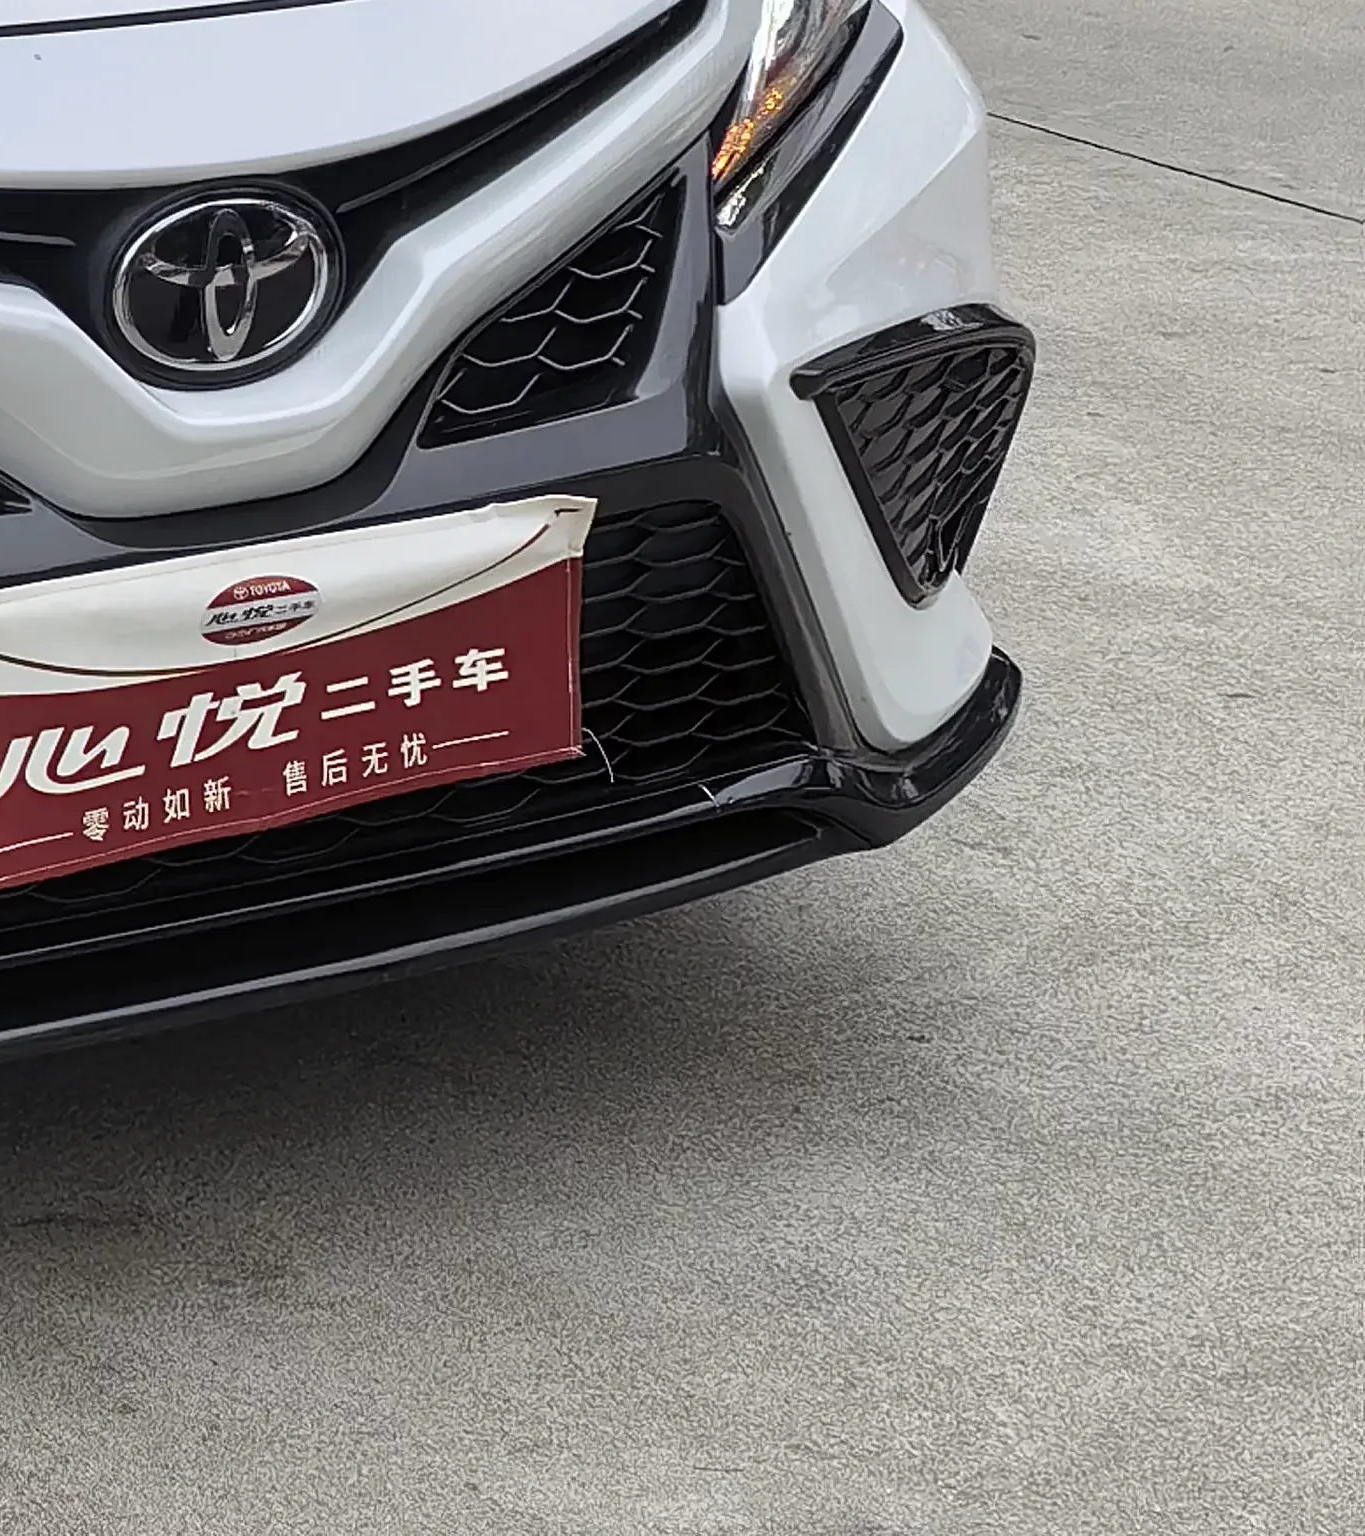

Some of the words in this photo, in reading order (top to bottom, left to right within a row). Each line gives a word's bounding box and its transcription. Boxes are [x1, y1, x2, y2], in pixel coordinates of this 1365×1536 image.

[250, 580, 290, 597] TOYOTA
[82, 777, 232, 843] 零动如新
[282, 731, 428, 798] 售后无忧
